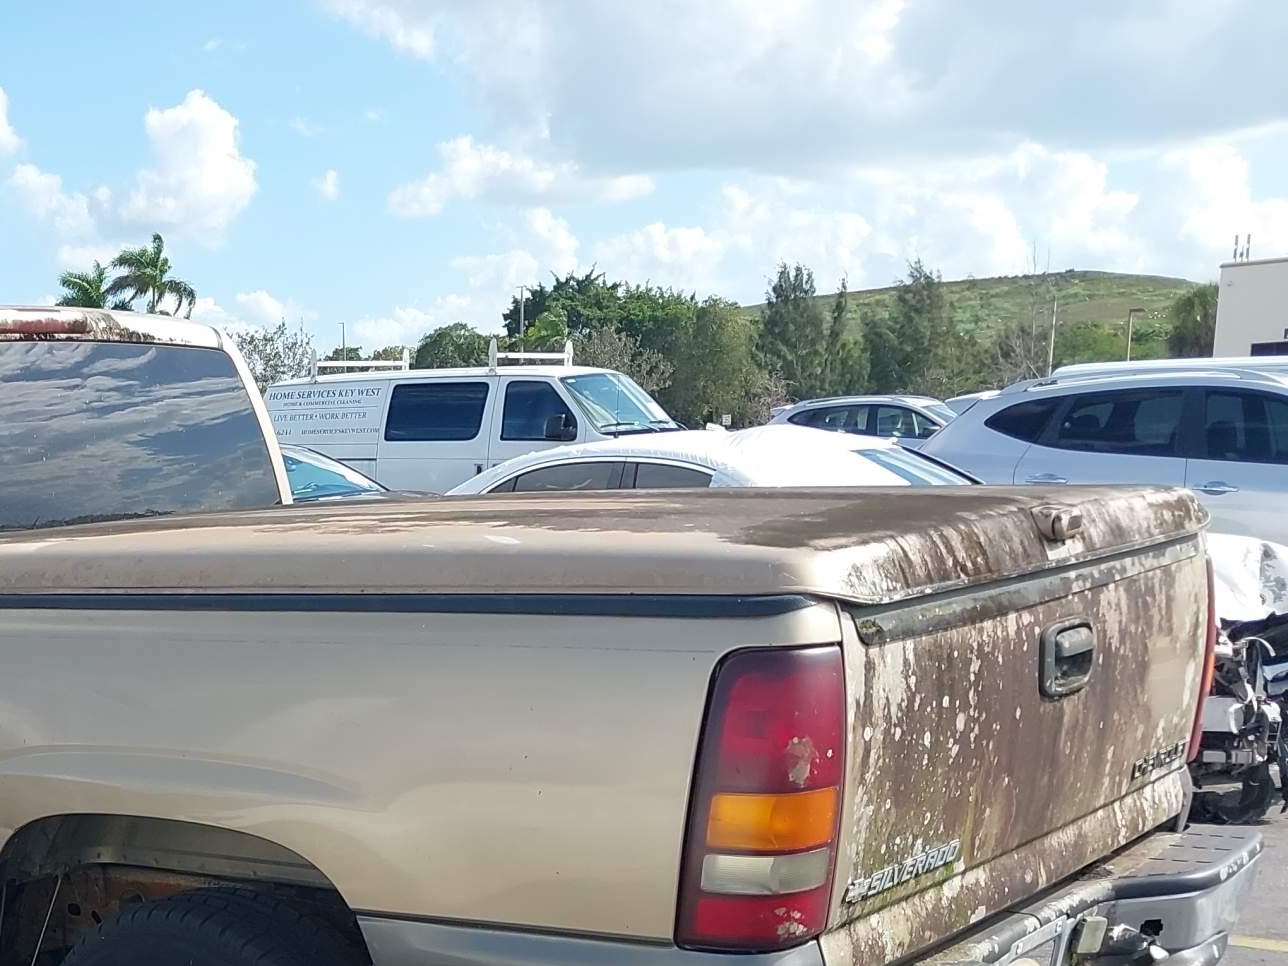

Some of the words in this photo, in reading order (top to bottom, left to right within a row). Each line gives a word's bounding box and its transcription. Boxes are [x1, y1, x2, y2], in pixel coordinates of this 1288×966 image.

[269, 391, 296, 401] HOME
[296, 389, 337, 400] SERVICES
[338, 388, 357, 398] KEY
[357, 387, 382, 397] WEST
[274, 414, 289, 422] LIVE
[289, 413, 313, 421] BETTER
[318, 412, 339, 421] WORK
[341, 411, 367, 420] BETTER
[867, 838, 961, 896] SILVERADO
